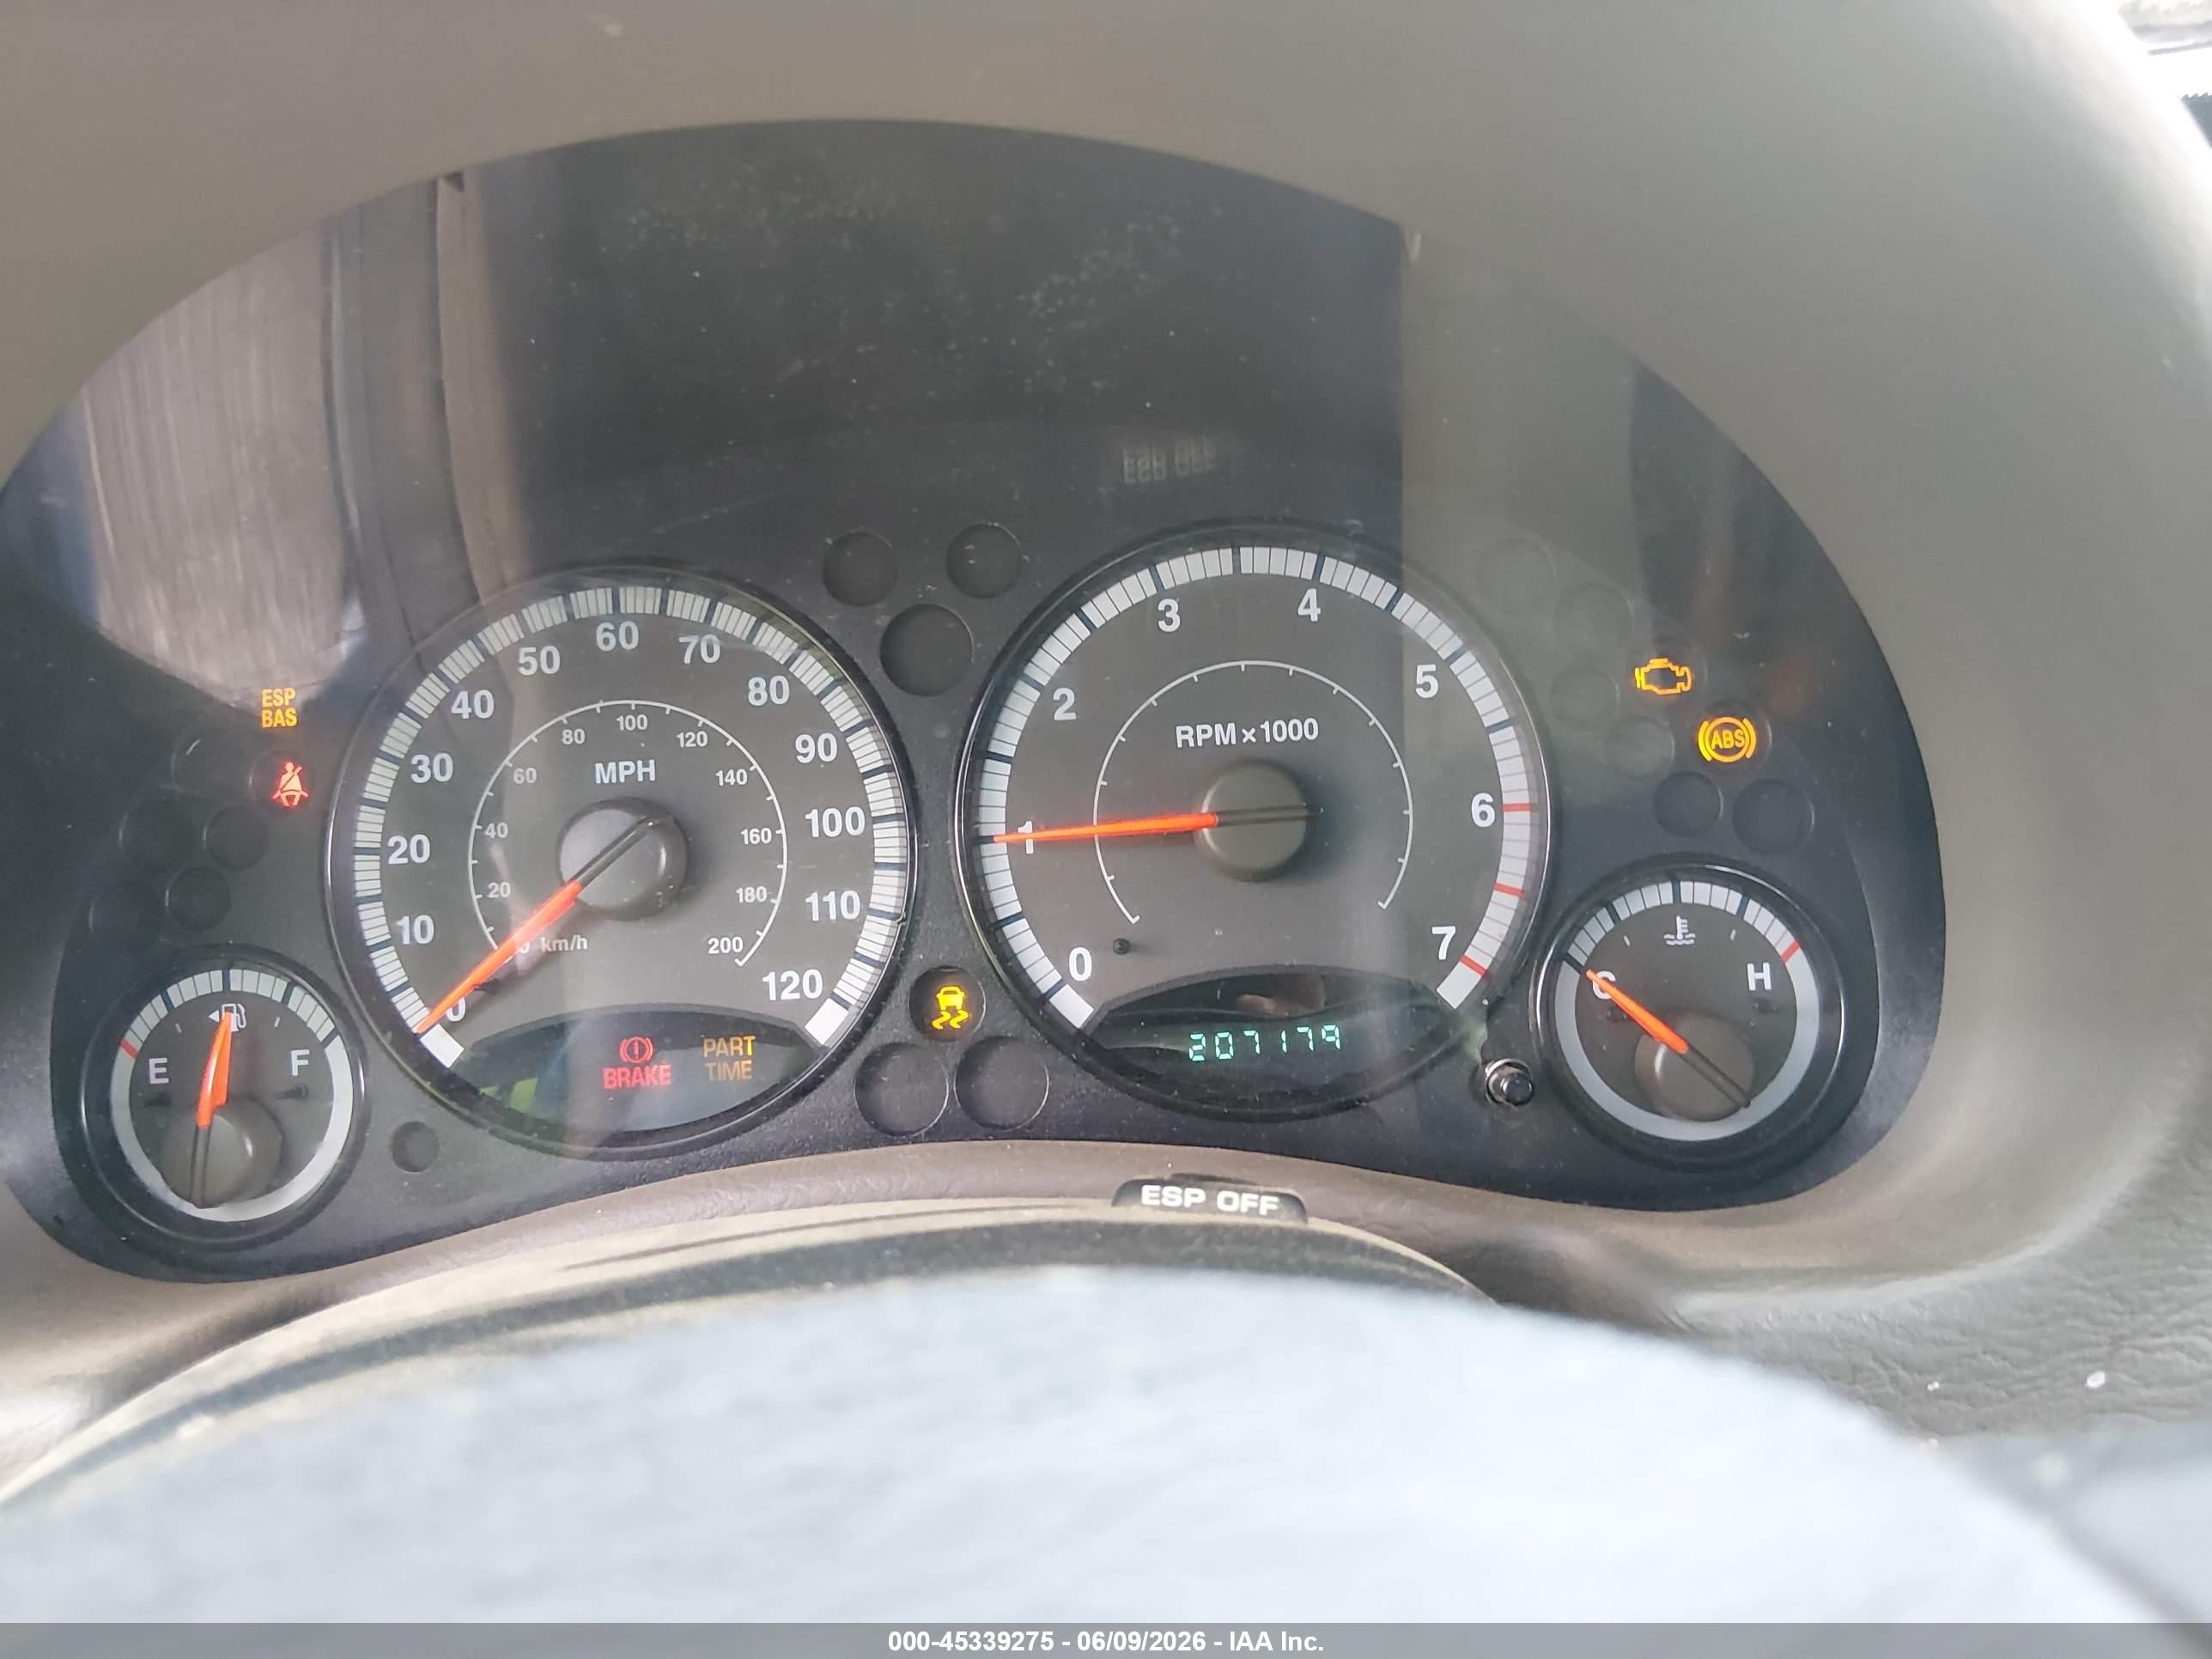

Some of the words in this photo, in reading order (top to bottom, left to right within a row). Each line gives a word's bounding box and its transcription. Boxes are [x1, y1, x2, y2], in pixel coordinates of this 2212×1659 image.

[1158, 598, 1181, 633] 3
[1297, 587, 1322, 622] 4
[596, 620, 640, 652] 60
[678, 634, 720, 665] 70
[518, 645, 561, 676] 50
[748, 675, 790, 707] 80
[1415, 664, 1439, 699] 5
[261, 687, 296, 708] ESP
[451, 689, 495, 720] 40
[1053, 687, 1077, 721] 2
[261, 708, 297, 728] BAS
[616, 714, 648, 732] 100
[1176, 722, 1237, 748] RPM
[1260, 717, 1319, 743] 1000
[562, 728, 586, 745] 80
[676, 730, 708, 748] 120
[795, 732, 838, 763] 90
[1711, 728, 1746, 750] ABS
[410, 752, 453, 784] 30
[513, 767, 538, 785] 60
[594, 759, 656, 784] MPH
[715, 769, 748, 787] 140
[805, 806, 866, 838] 100
[1471, 792, 1496, 828] 6
[484, 822, 509, 839] 40
[740, 827, 772, 845] 160
[1017, 820, 1034, 854] 1
[387, 834, 431, 865] 20
[487, 881, 512, 898] 20
[736, 885, 768, 903] 180
[805, 890, 860, 921] 110
[395, 915, 434, 945] 10
[539, 933, 589, 952] km/h
[1431, 925, 1456, 960] 7
[708, 936, 744, 955] 200
[1068, 946, 1092, 981] 0
[1747, 962, 1771, 991] H
[762, 969, 823, 1001] 120
[703, 1036, 757, 1058] PART
[1188, 1024, 1340, 1061] 207179
[149, 1057, 169, 1085] E
[290, 1048, 310, 1077] F
[603, 1064, 672, 1090] BRAKE
[704, 1060, 753, 1081] TIME
[1141, 1184, 1206, 1208] ESP
[1217, 1190, 1280, 1216] OFF
